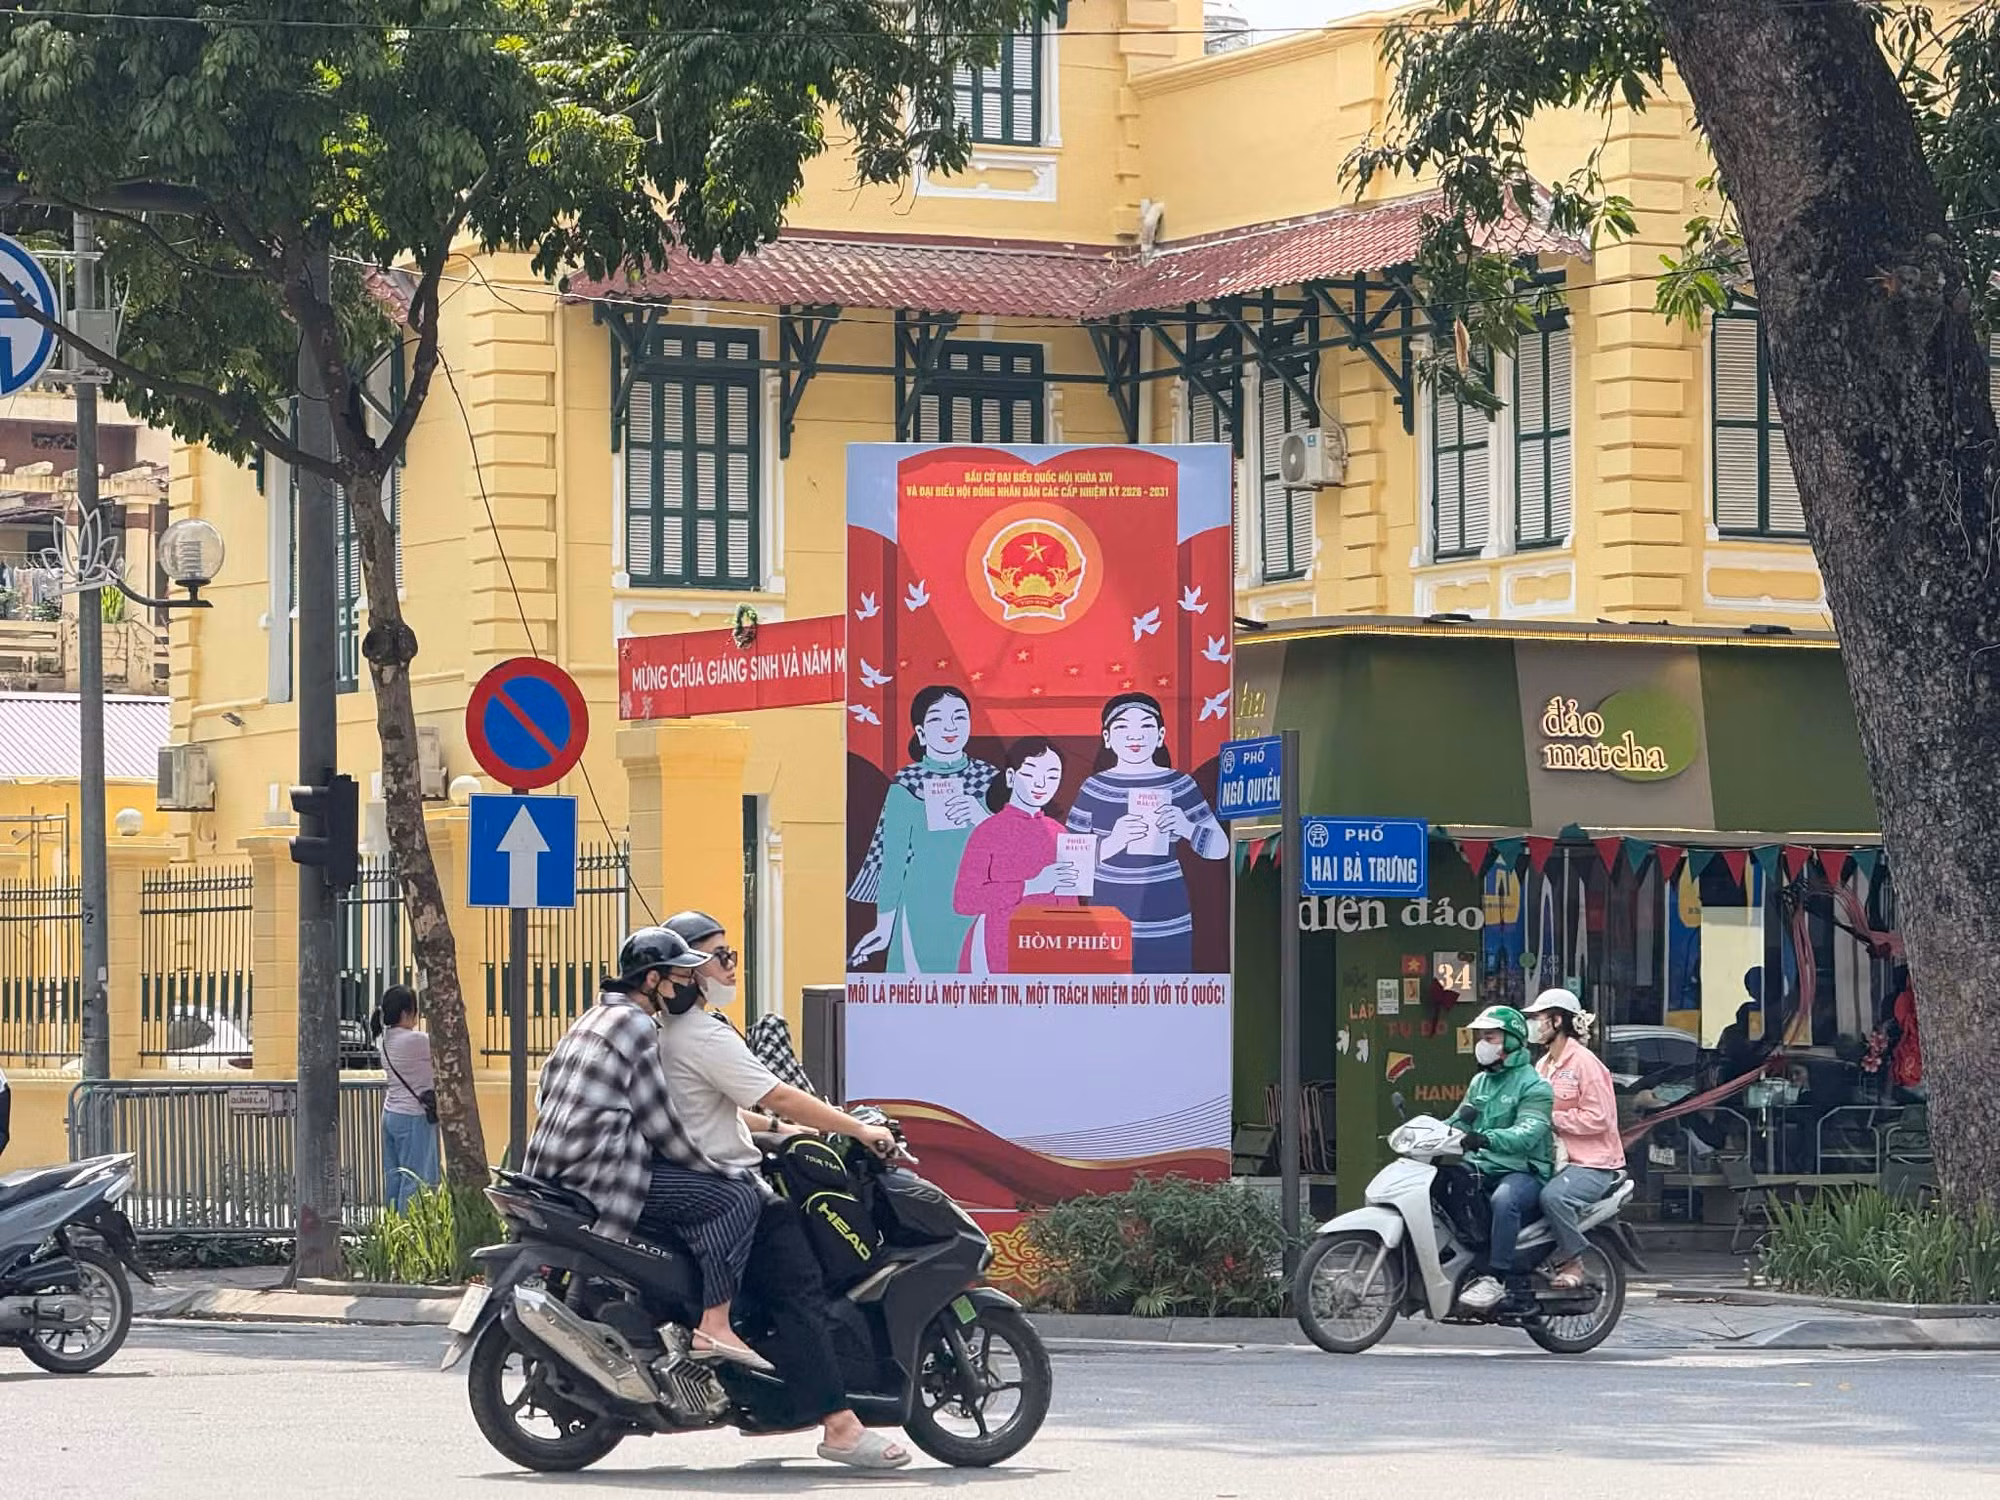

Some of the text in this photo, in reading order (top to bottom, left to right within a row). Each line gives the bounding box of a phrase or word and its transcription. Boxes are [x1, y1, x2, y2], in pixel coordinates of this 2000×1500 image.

[906, 484, 918, 497] VÀ
[920, 486, 934, 500] ĐẠI
[957, 484, 971, 499] HỘI
[998, 485, 1021, 497] NHÂN
[1023, 485, 1041, 497] DÂN
[1042, 485, 1060, 497] CÁC
[1061, 484, 1078, 497] CẤP
[1080, 485, 1107, 499] NHIỆM
[1149, 487, 1169, 497] 2031
[1034, 470, 1057, 483] QUỐC
[1058, 471, 1074, 485] HỘI
[1099, 471, 1113, 483] XVI
[632, 661, 668, 692] MỪNG
[670, 656, 704, 688] CHÚA
[707, 653, 747, 685] GIÁNG
[750, 655, 779, 682] SINH
[783, 646, 800, 678] VÀ
[802, 643, 832, 677] NĂM
[1543, 696, 1605, 737] đảo
[1243, 745, 1266, 766] PHỐ
[1543, 730, 1668, 772] matcha
[1222, 768, 1281, 808] NGÔ QUYỀN
[1344, 825, 1384, 842] PHỐ
[1311, 851, 1417, 884] HAI BÀ TRƯNG
[1018, 931, 1122, 950] HÒM PHIẾU
[848, 976, 1225, 1008] MỖI LÁ PHIẾU LÀ MỘT NIỀM TIN, MỘT TRÁCH NHIỆM ĐỐI VỚI TỔ QUỐC!
[1437, 962, 1473, 991] 34
[818, 1202, 872, 1261] HEAD
